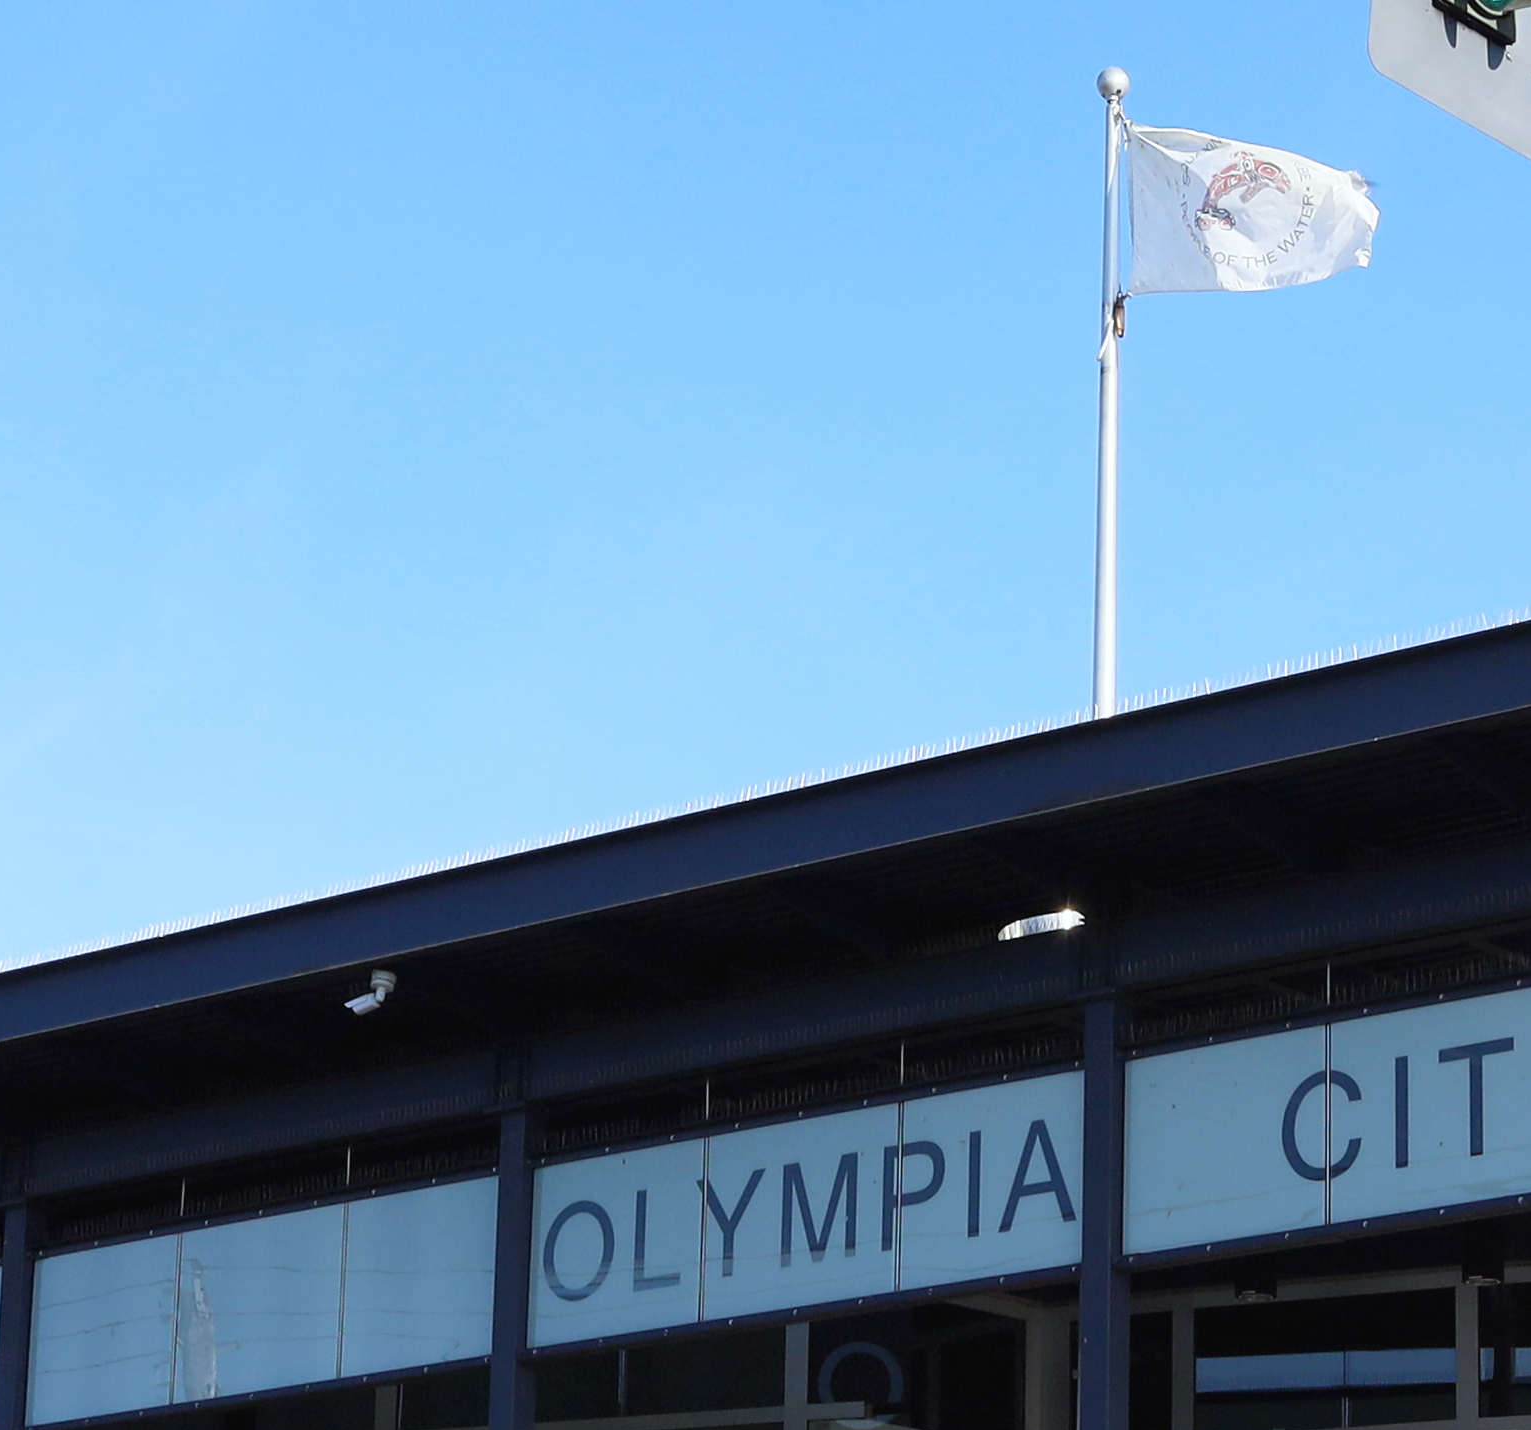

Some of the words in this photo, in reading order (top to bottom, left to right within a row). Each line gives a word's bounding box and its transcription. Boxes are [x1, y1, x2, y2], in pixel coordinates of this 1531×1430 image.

[1213, 251, 1237, 266] OF
[1243, 250, 1278, 268] THE
[1277, 193, 1315, 254] WATER
[542, 1119, 1077, 1303] OLYMPIA
